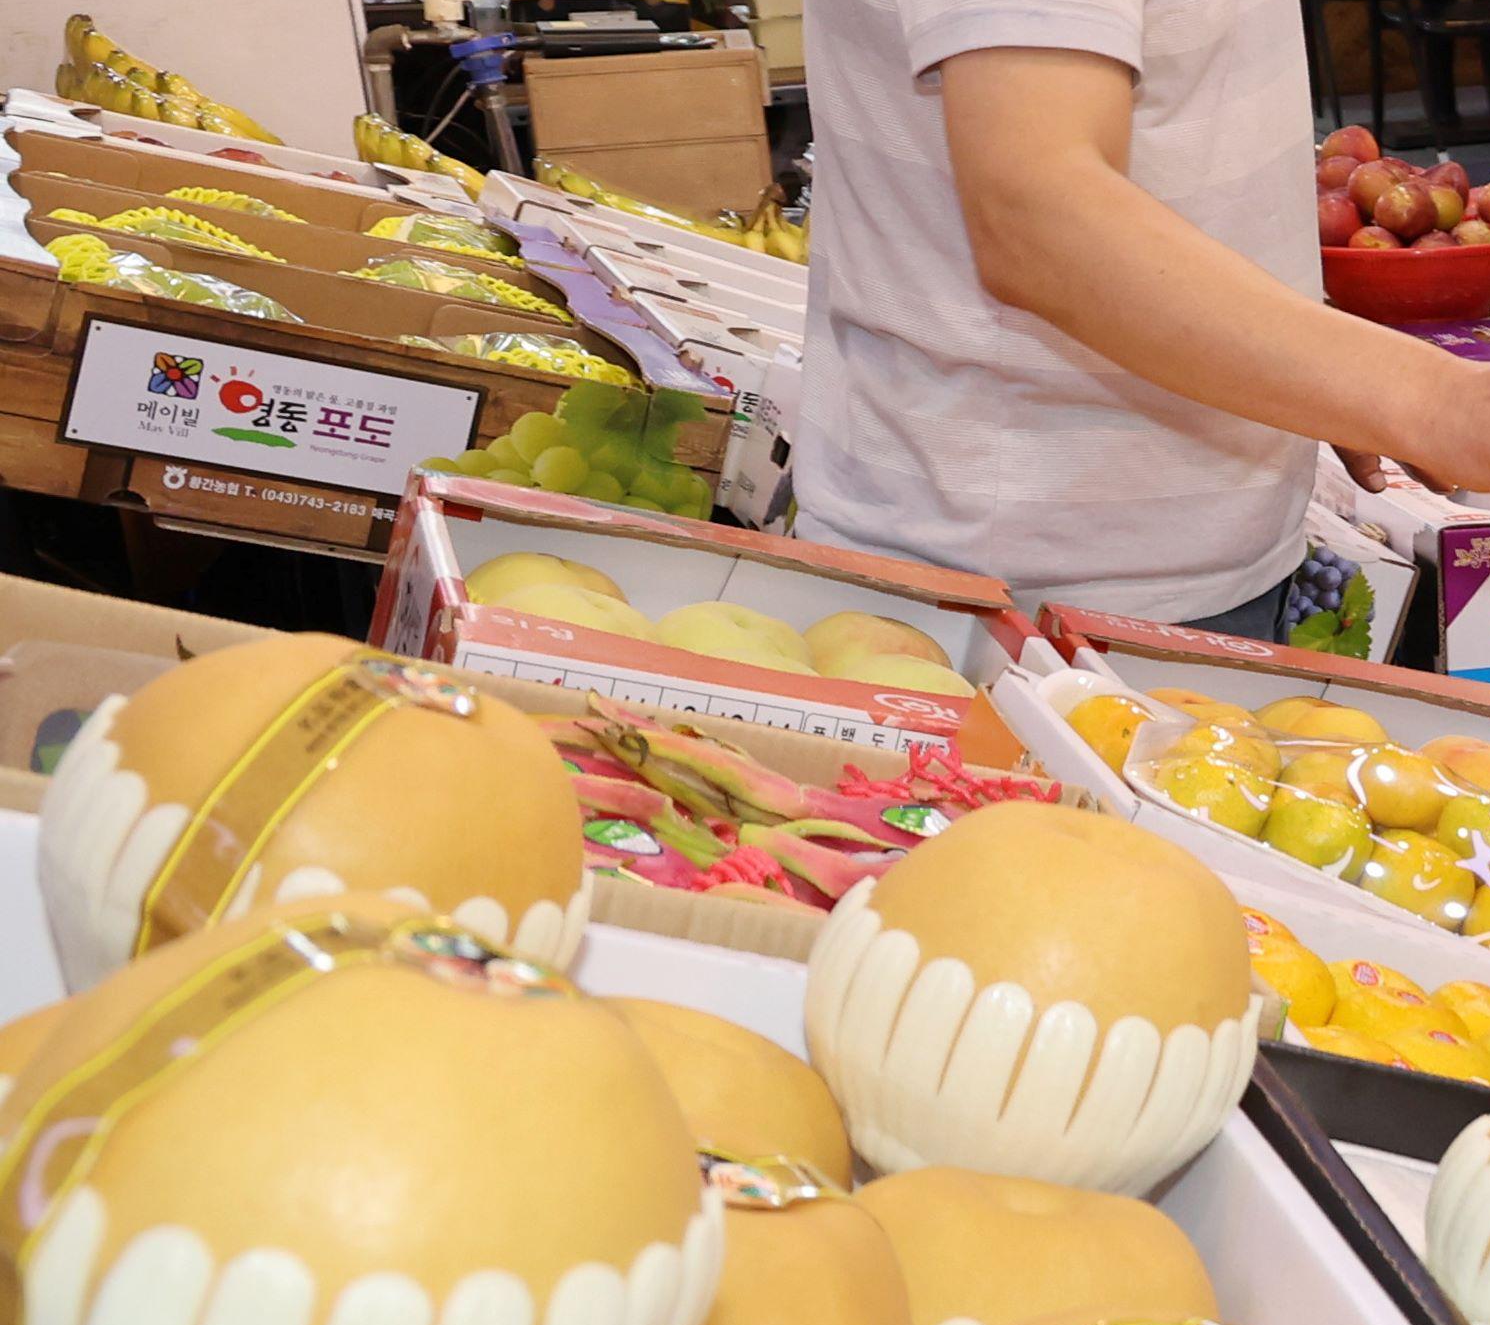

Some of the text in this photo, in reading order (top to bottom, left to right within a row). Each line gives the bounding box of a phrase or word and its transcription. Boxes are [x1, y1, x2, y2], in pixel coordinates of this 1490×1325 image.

[137, 400, 200, 429] 메이빌
[219, 380, 394, 448] 영동 포도
[188, 476, 239, 497] 황간농협
